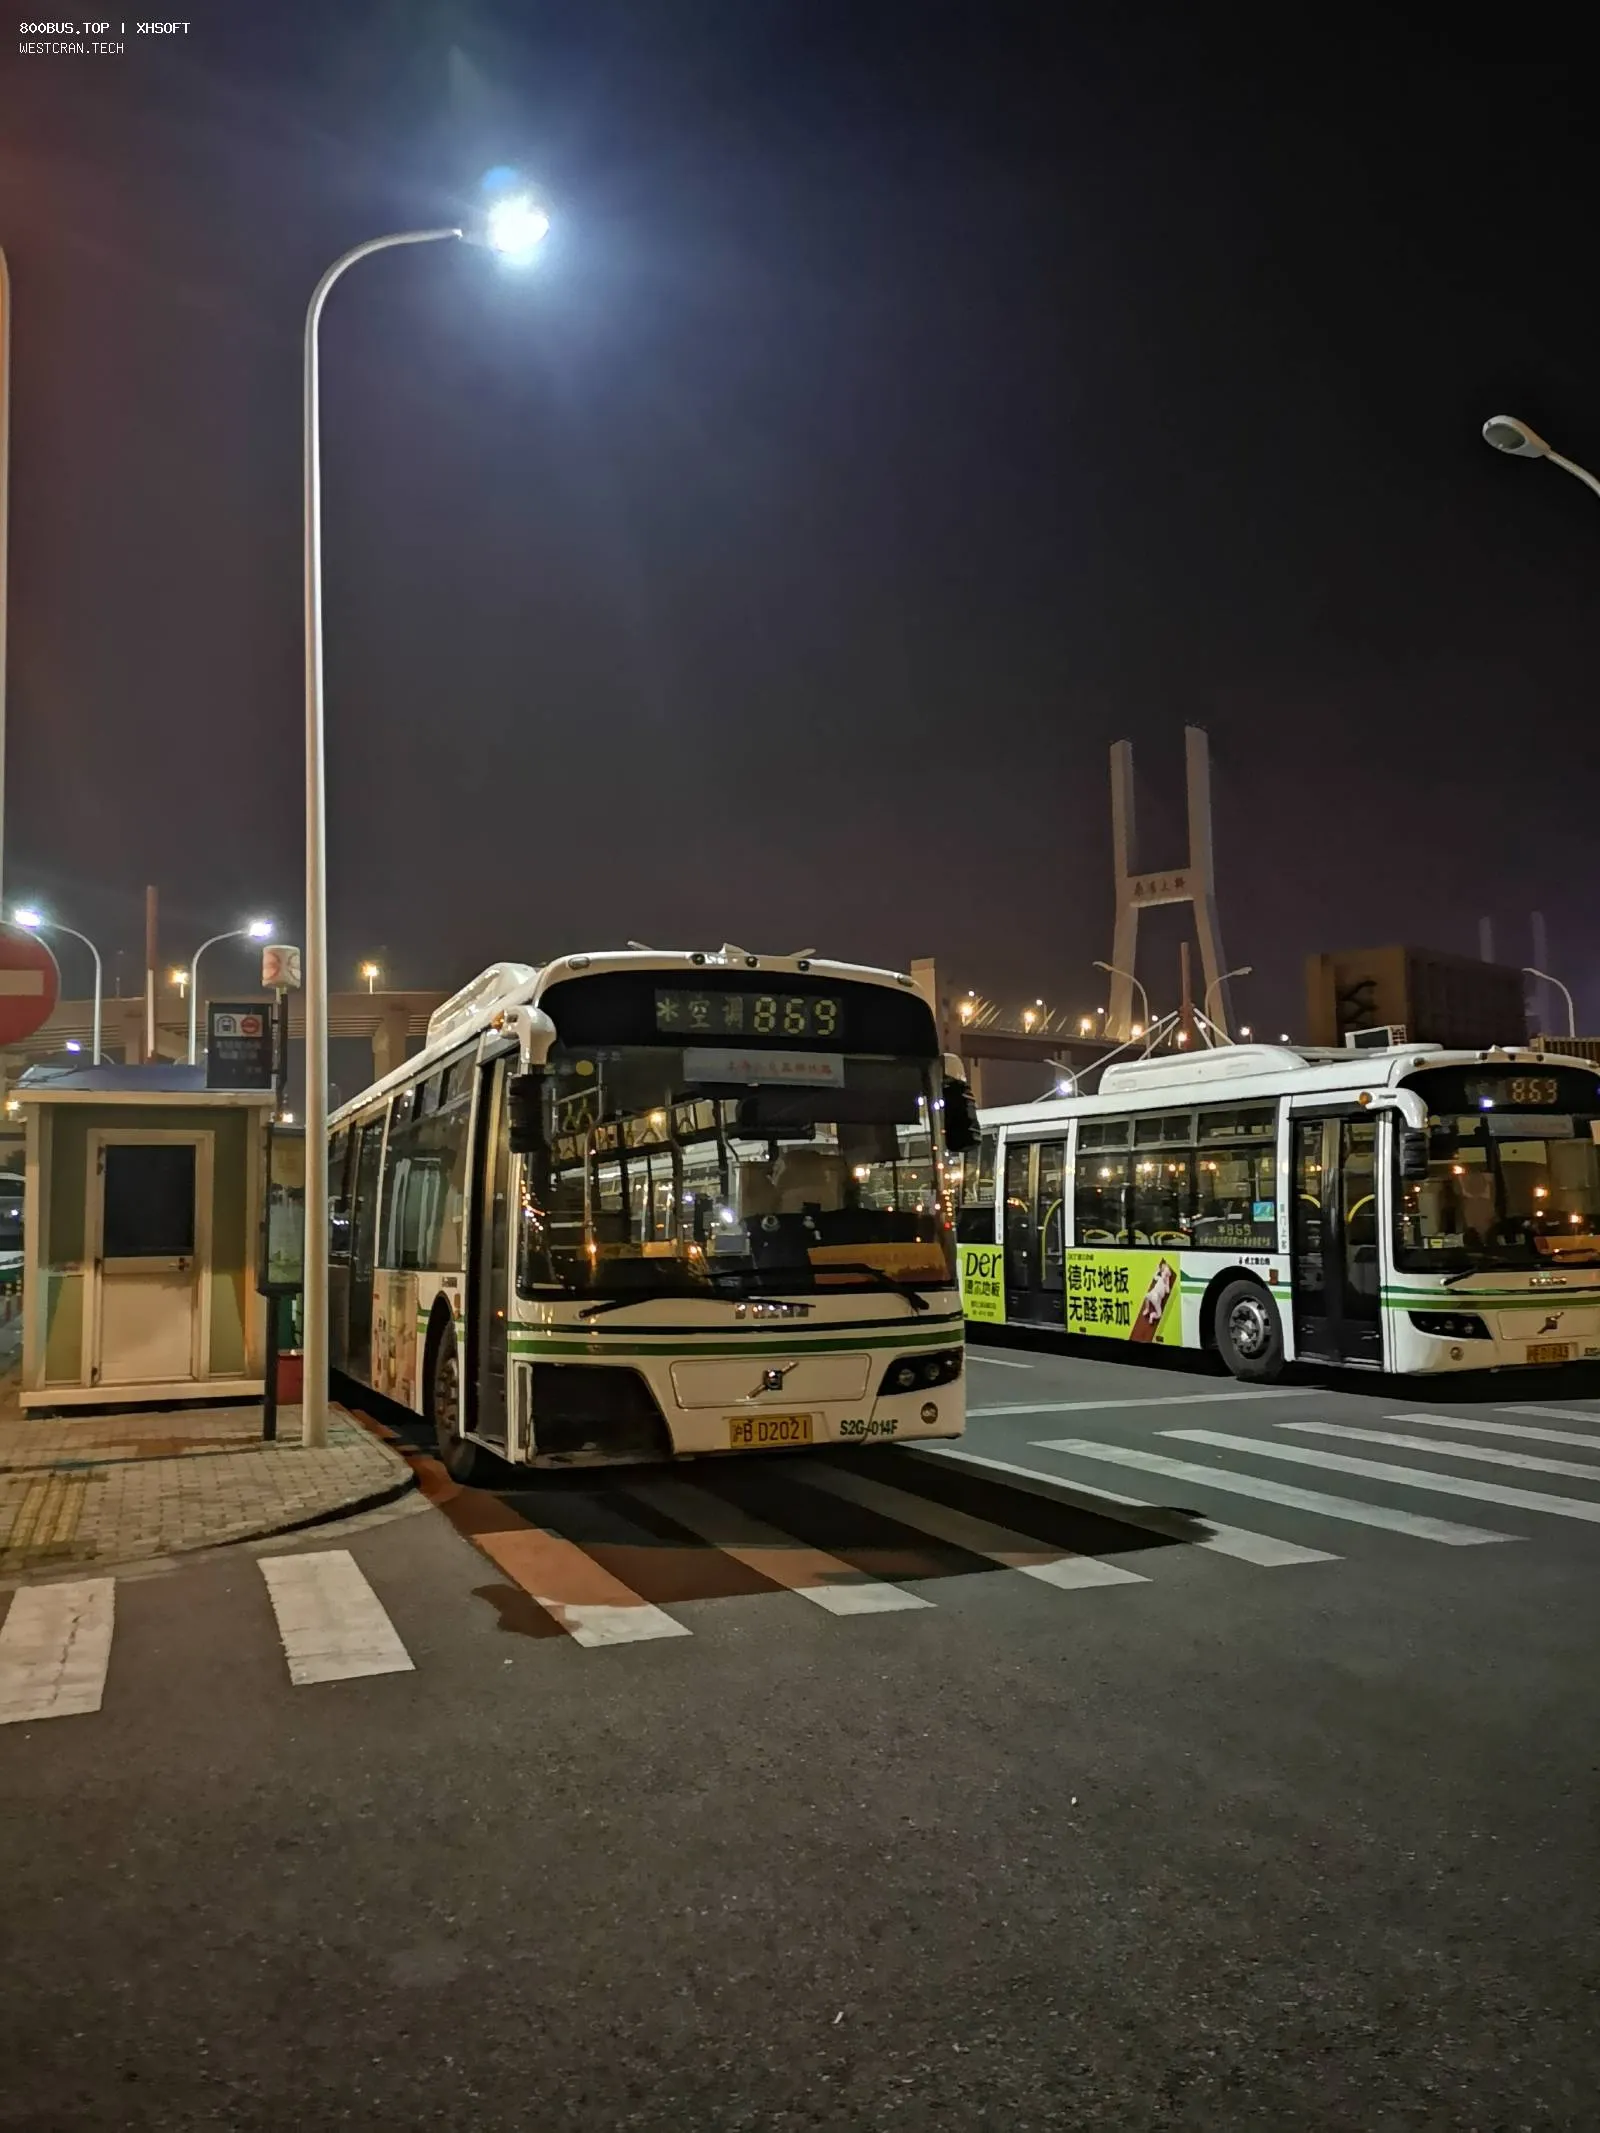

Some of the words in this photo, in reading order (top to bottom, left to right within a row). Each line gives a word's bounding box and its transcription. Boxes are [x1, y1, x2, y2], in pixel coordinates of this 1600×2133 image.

[753, 996, 837, 1035] 869
[965, 1251, 1002, 1279] Der
[1067, 1264, 1130, 1295] 德尔地板
[1068, 1295, 1131, 1327] 无醛添加
[758, 1419, 808, 1443] D2021
